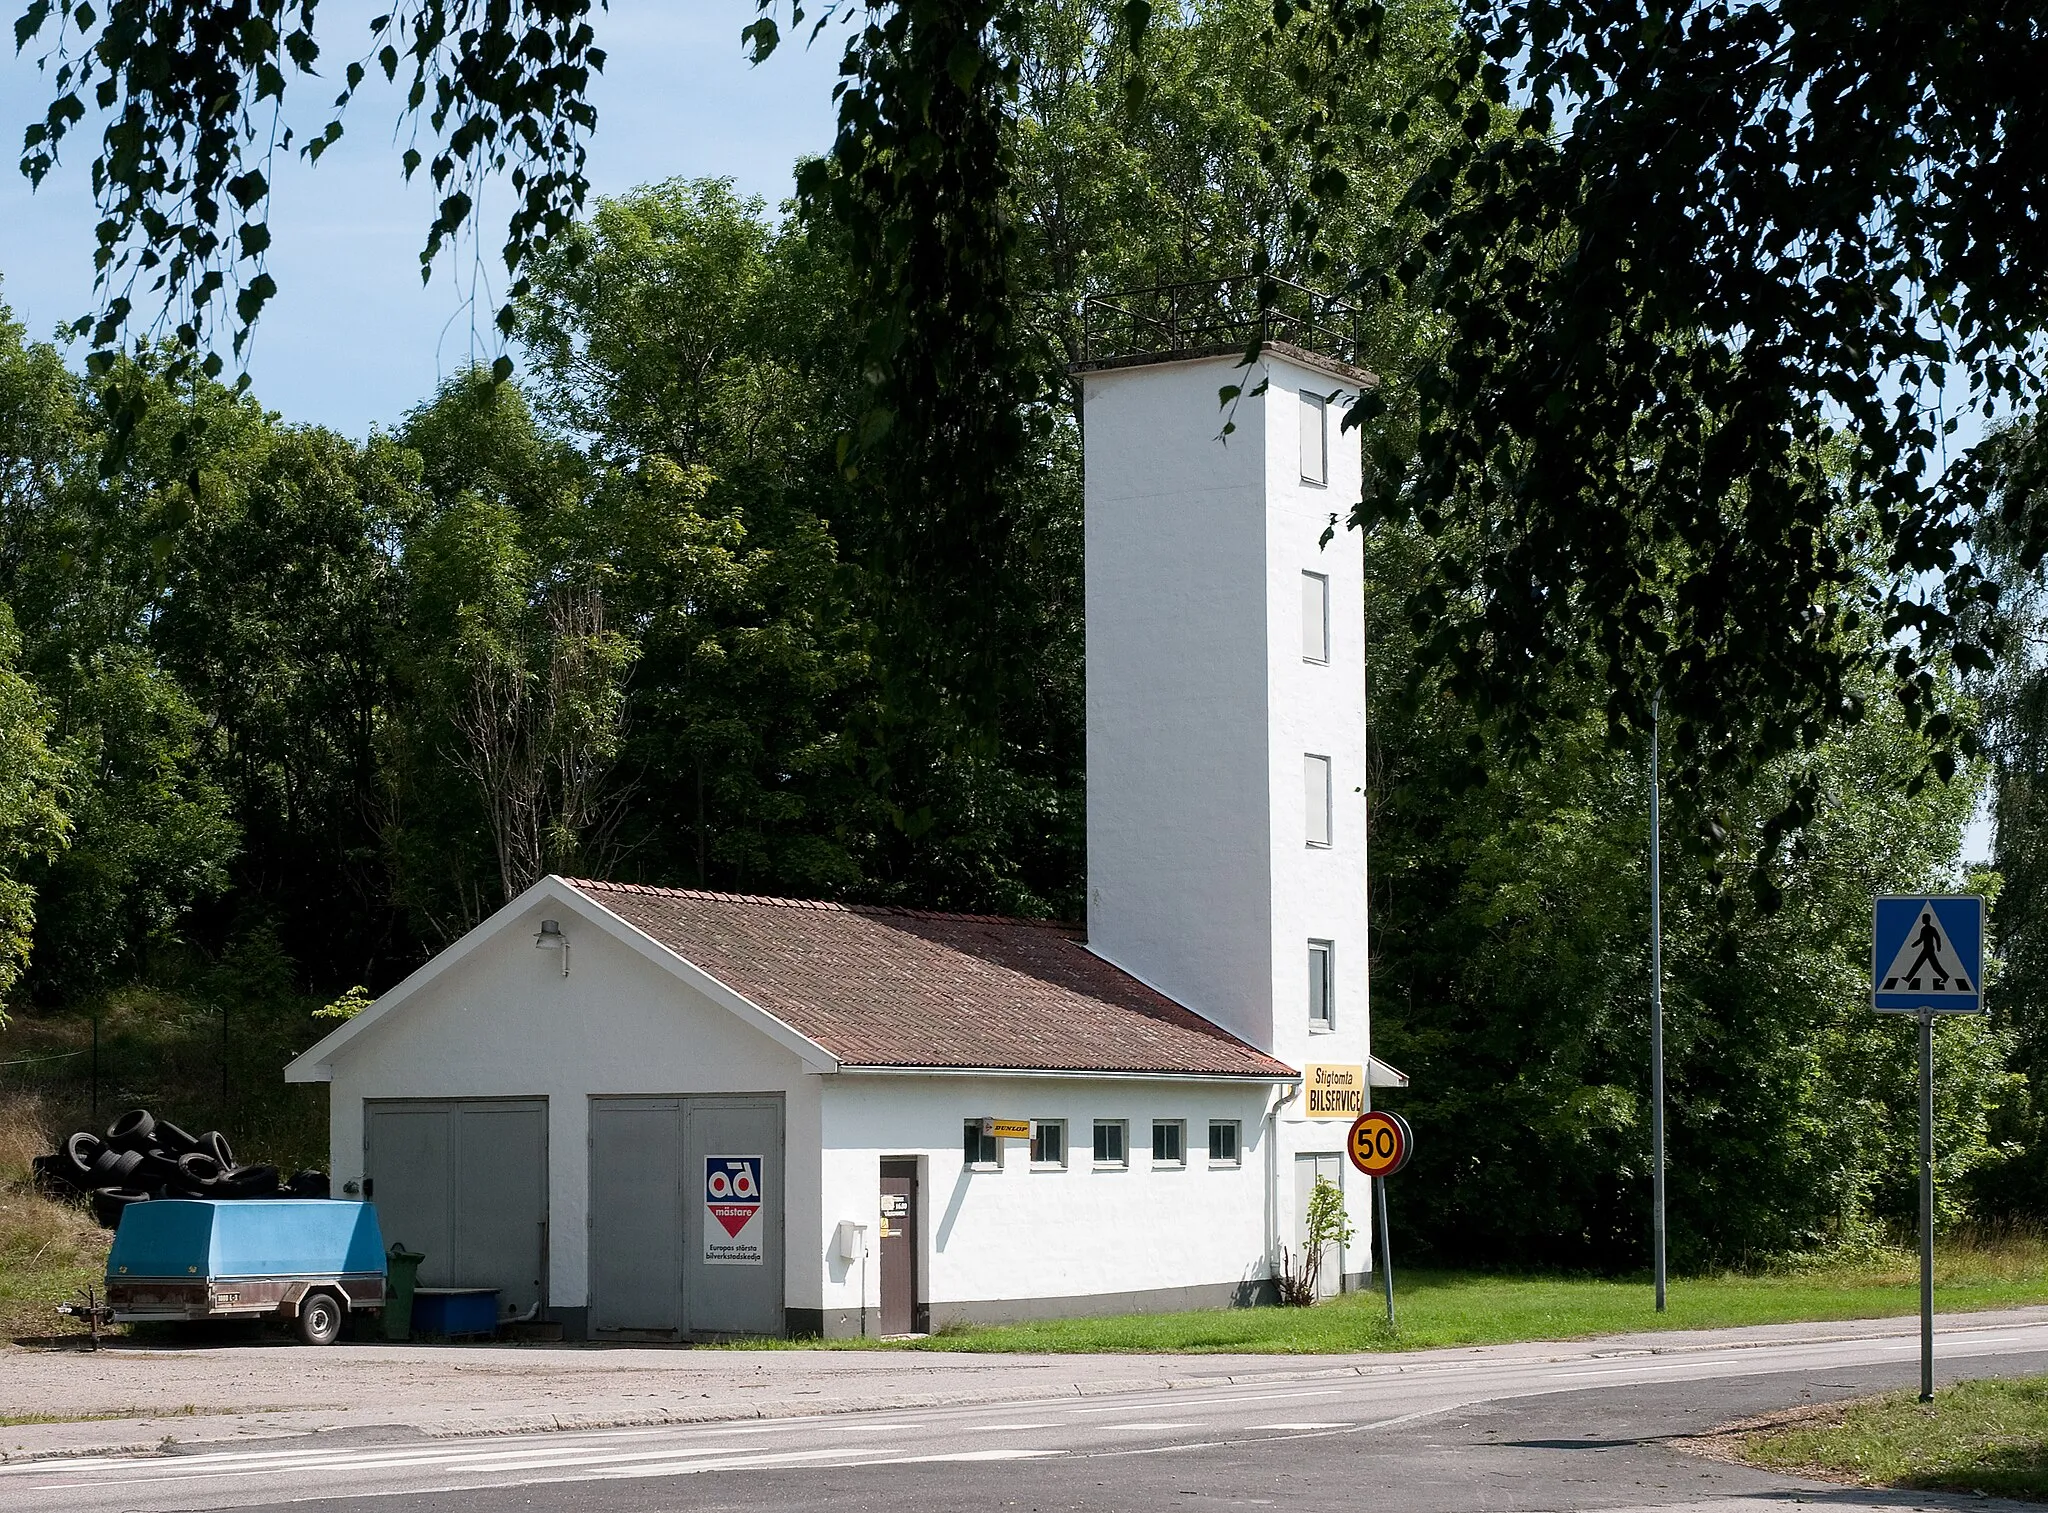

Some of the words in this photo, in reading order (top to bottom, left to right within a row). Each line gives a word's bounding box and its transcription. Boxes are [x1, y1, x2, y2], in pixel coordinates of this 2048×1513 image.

[1315, 1068, 1353, 1087] Stigtomta
[1310, 1090, 1360, 1112] BILSERVICE
[1357, 1127, 1394, 1160] 50
[716, 1207, 752, 1217] mästare
[709, 1244, 735, 1253] Europas
[736, 1244, 757, 1252] största
[706, 1252, 761, 1261] bilverkstadskedja
